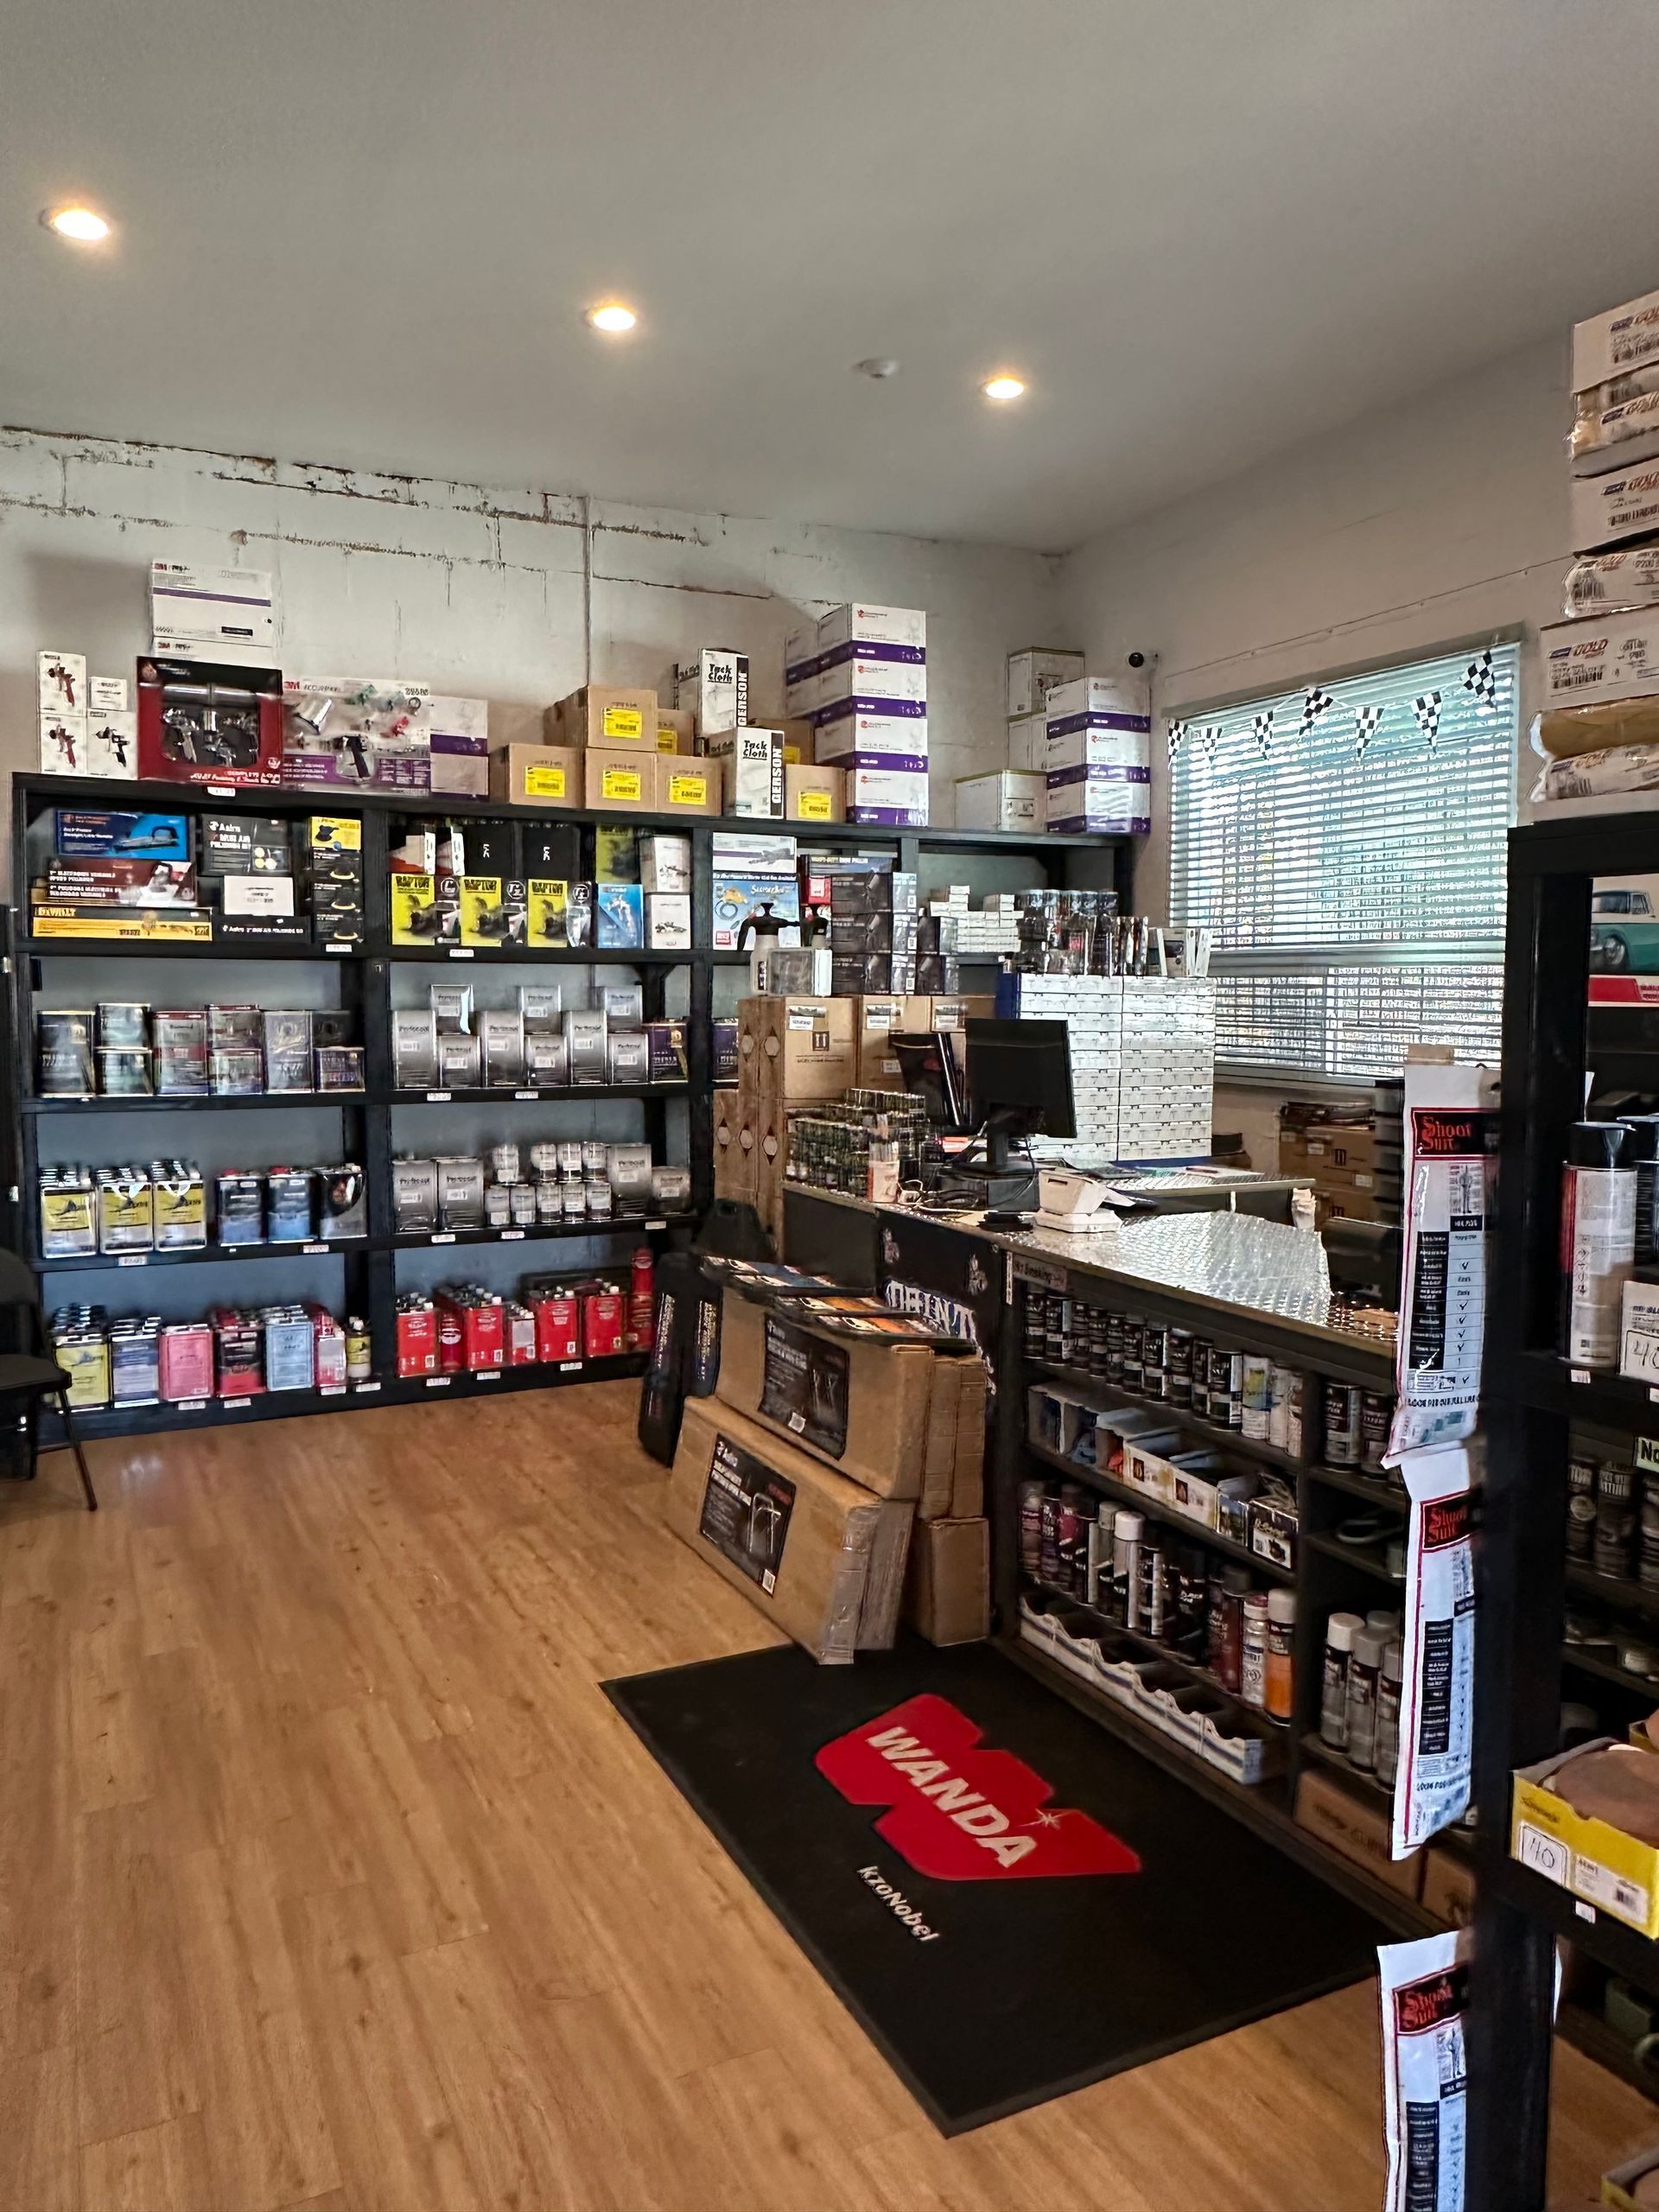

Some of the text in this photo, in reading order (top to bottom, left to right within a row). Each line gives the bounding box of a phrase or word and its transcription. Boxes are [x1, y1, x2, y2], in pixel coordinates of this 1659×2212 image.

[708, 671, 733, 682] Cloth
[737, 671, 747, 727] GERSON
[743, 749, 767, 759] Cloth
[772, 748, 782, 804] GERSON
[464, 879, 497, 891] RAPTOR
[865, 1726, 1037, 1867] WANDA
